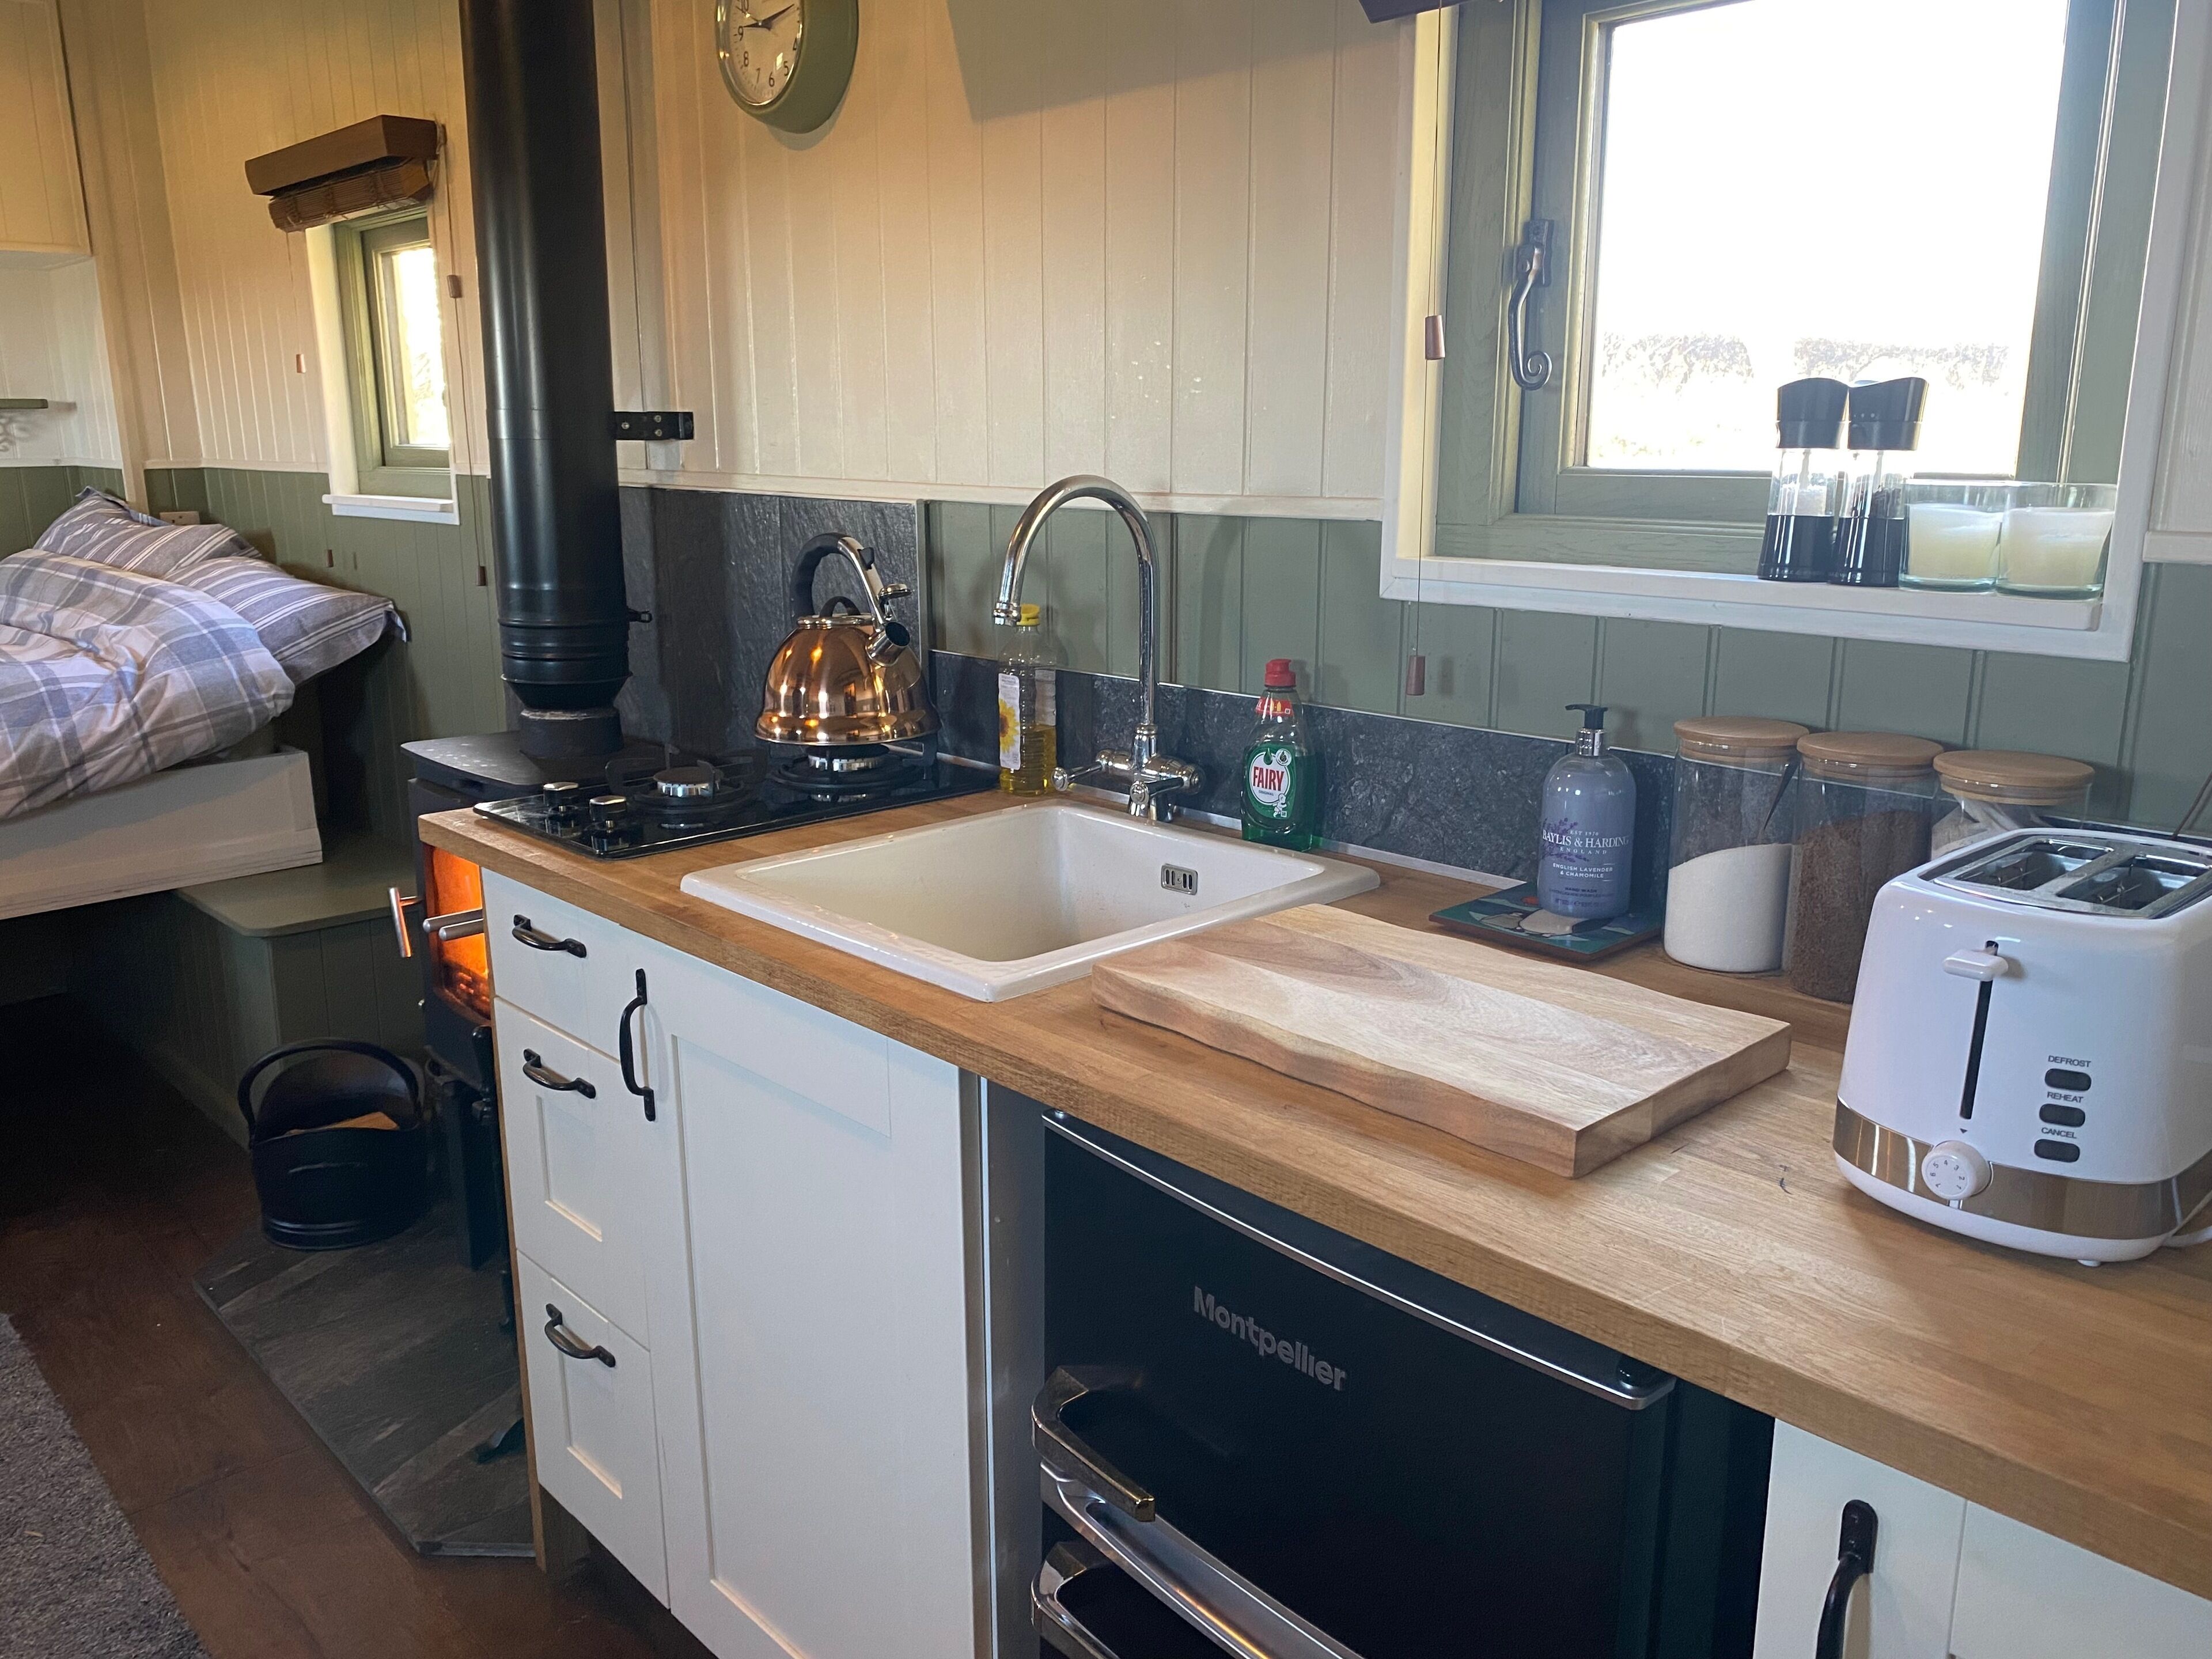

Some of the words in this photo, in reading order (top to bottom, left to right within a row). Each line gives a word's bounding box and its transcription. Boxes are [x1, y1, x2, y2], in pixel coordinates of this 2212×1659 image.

[737, 25, 743, 41] 9
[743, 51, 749, 67] 8
[756, 67, 761, 84] 7
[783, 60, 789, 76] 5
[768, 71, 775, 88] 6
[1253, 766, 1284, 791] FAIRY
[1542, 829, 1571, 846] BAYLIS
[1574, 838, 1583, 847] &
[1585, 835, 1630, 848] HARDING
[1560, 846, 1607, 854] ENGLAND
[1552, 862, 1577, 871] ENGLISH
[1566, 870, 1604, 878] CHAMOMILE
[2047, 1055, 2092, 1069] DEFROST
[2047, 1091, 2084, 1104] REHEAT
[2041, 1126, 2077, 1139] CANCEL
[1194, 1286, 1347, 1392] Montpellier
